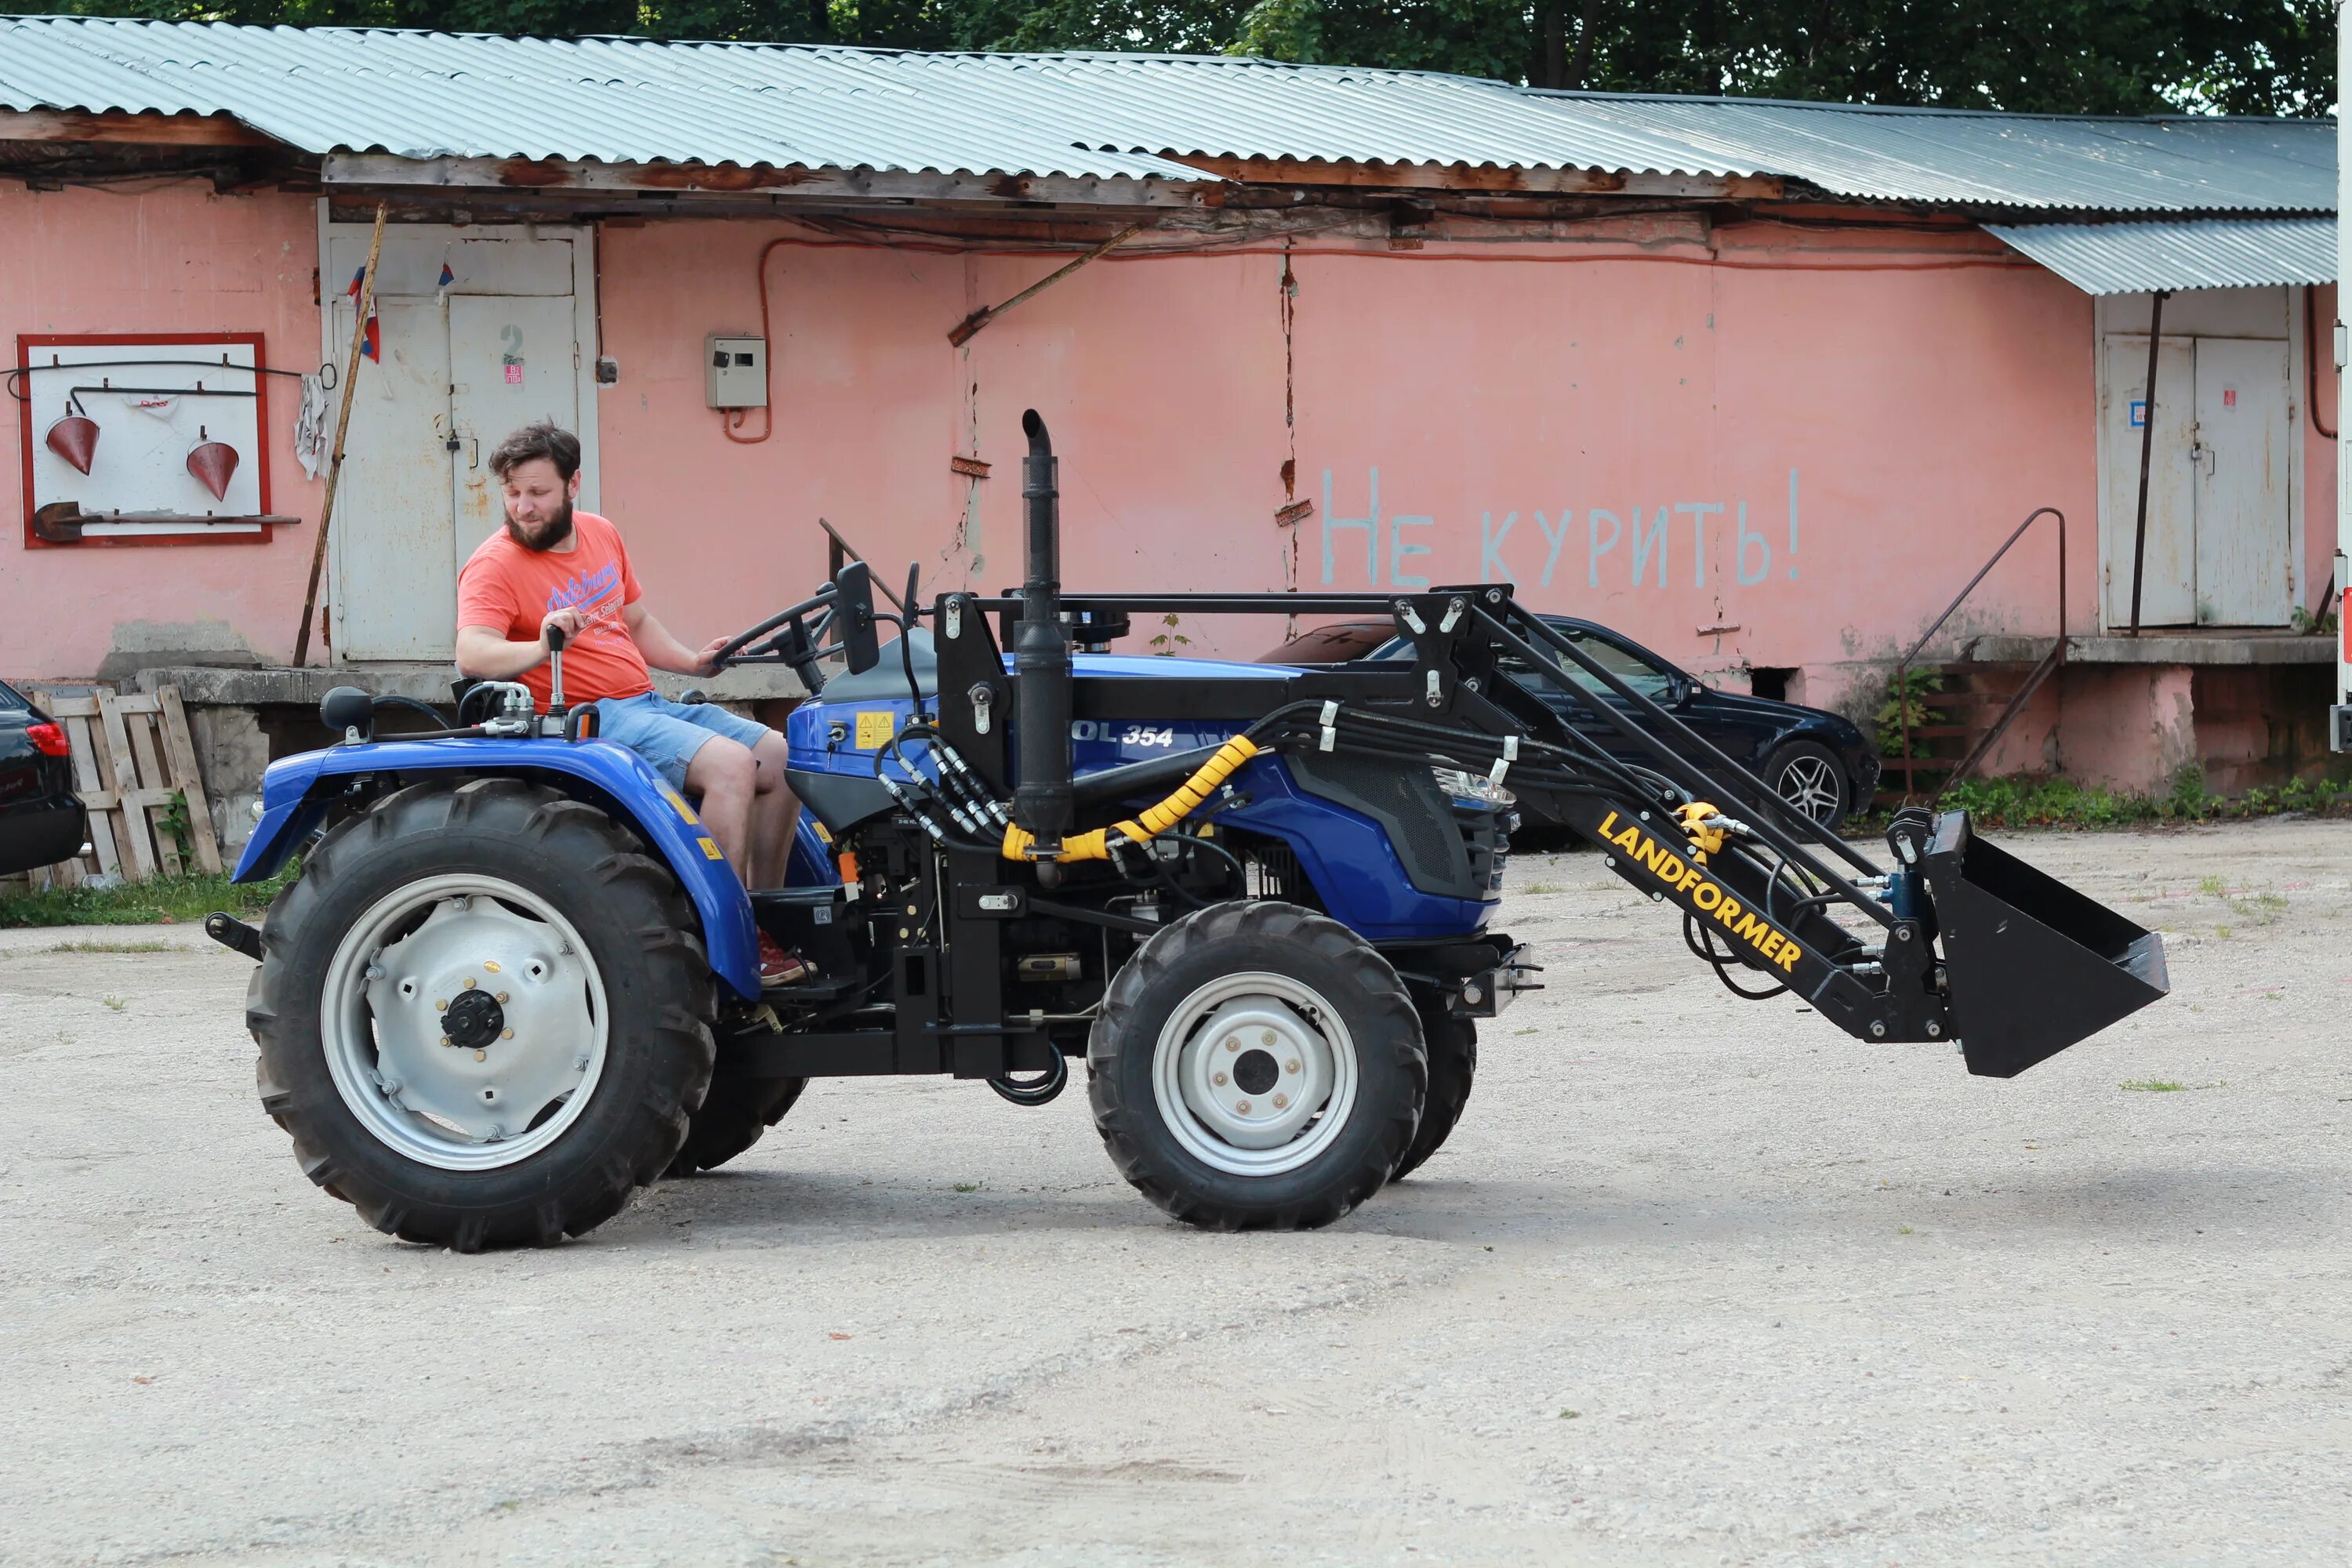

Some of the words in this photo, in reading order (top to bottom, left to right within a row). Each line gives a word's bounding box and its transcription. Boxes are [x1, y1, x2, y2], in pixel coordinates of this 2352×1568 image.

[500, 324, 524, 364] 2
[1071, 720, 1117, 742] OL
[1122, 724, 1174, 747] 354
[1598, 811, 1802, 973] LANDFORMER
